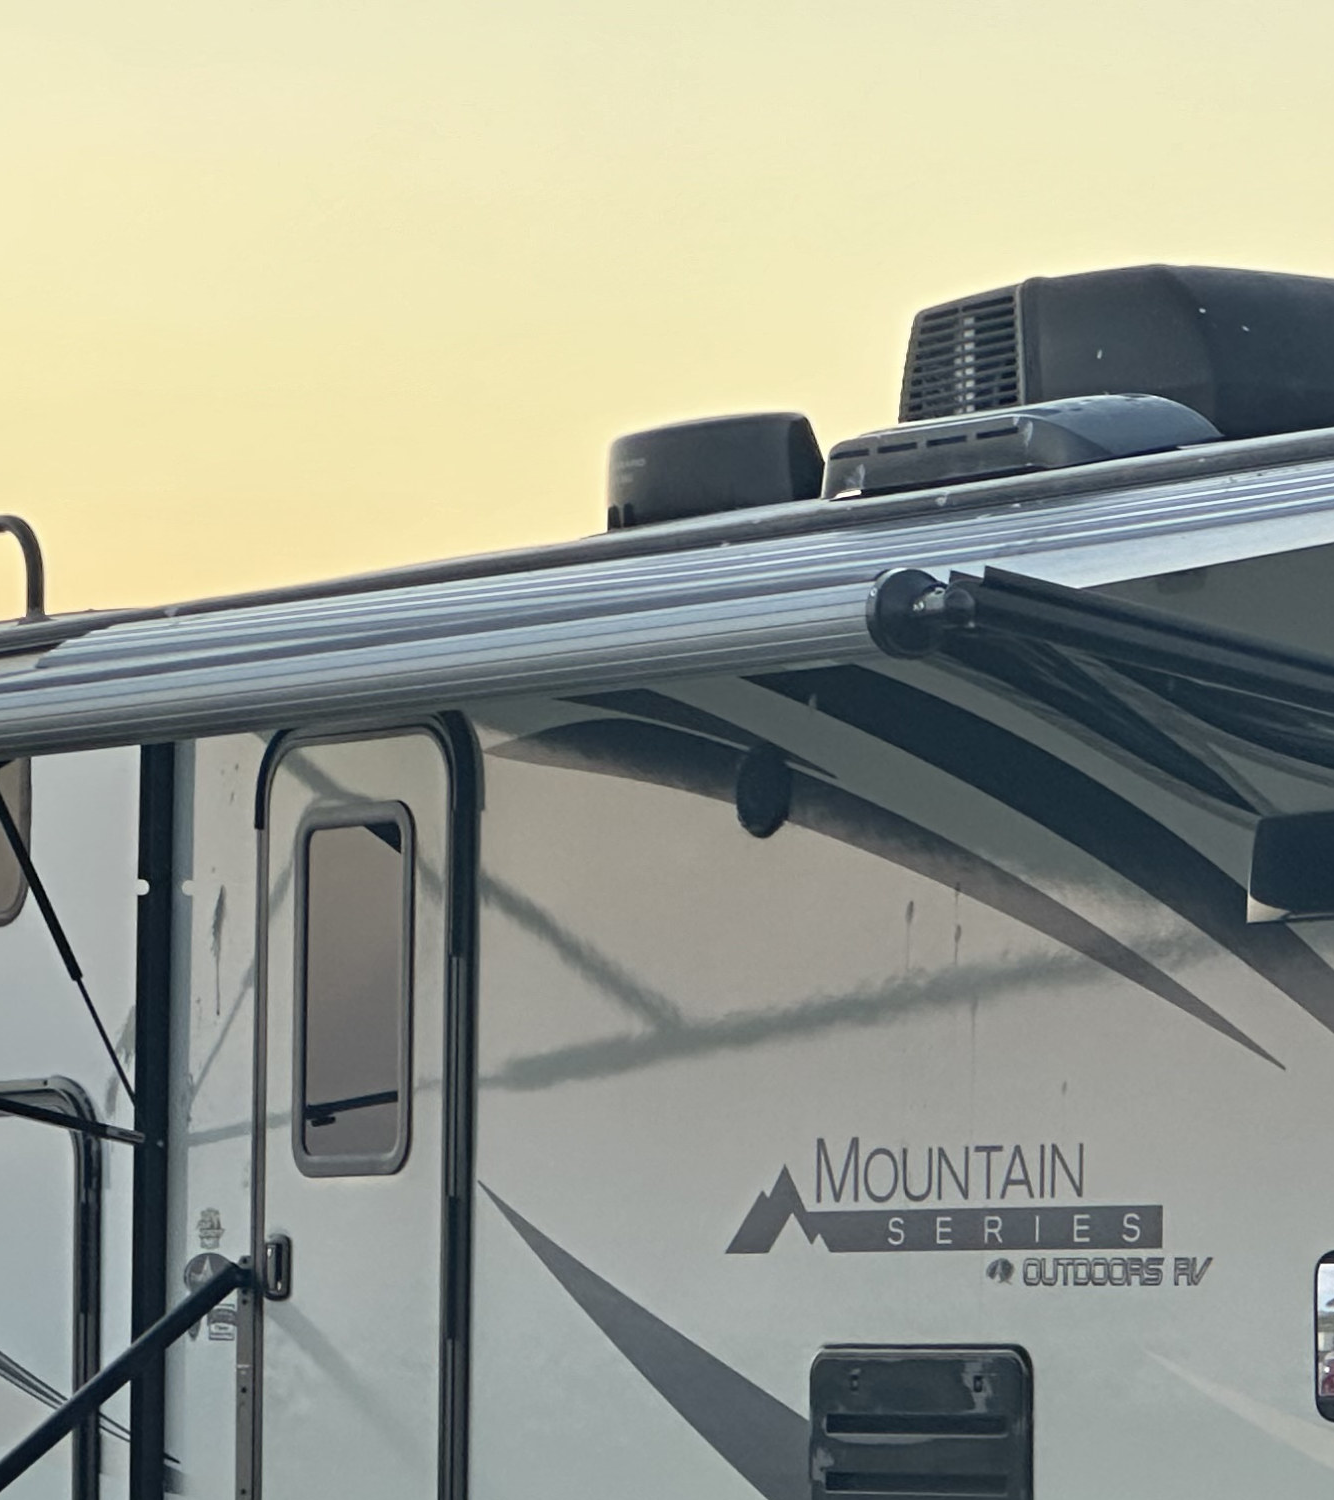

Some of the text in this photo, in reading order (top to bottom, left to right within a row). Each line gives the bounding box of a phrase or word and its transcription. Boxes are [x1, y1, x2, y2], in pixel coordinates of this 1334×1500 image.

[815, 1136, 1085, 1203] MOUNTAIN
[887, 1212, 1142, 1246] SERIES
[1023, 1256, 1214, 1286] OUTDOORS RV
